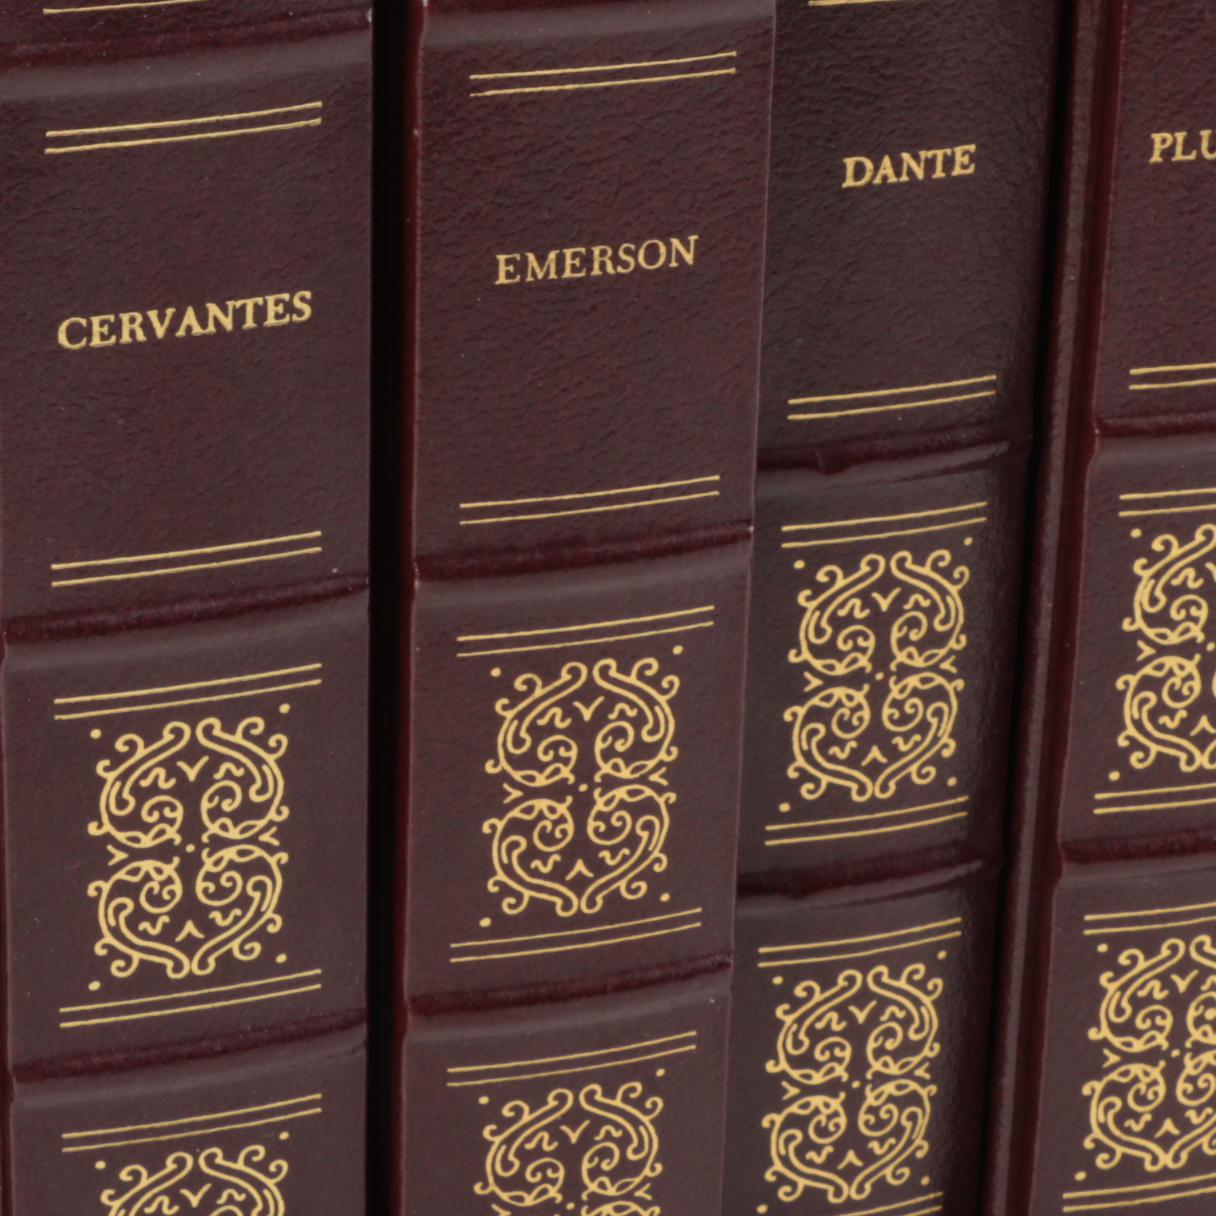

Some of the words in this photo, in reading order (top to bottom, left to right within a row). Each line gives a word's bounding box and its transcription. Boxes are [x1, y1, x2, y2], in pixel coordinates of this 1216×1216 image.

[841, 143, 977, 189] DANTE
[494, 234, 699, 285] EMERSON
[57, 290, 313, 351] CERVANTES
